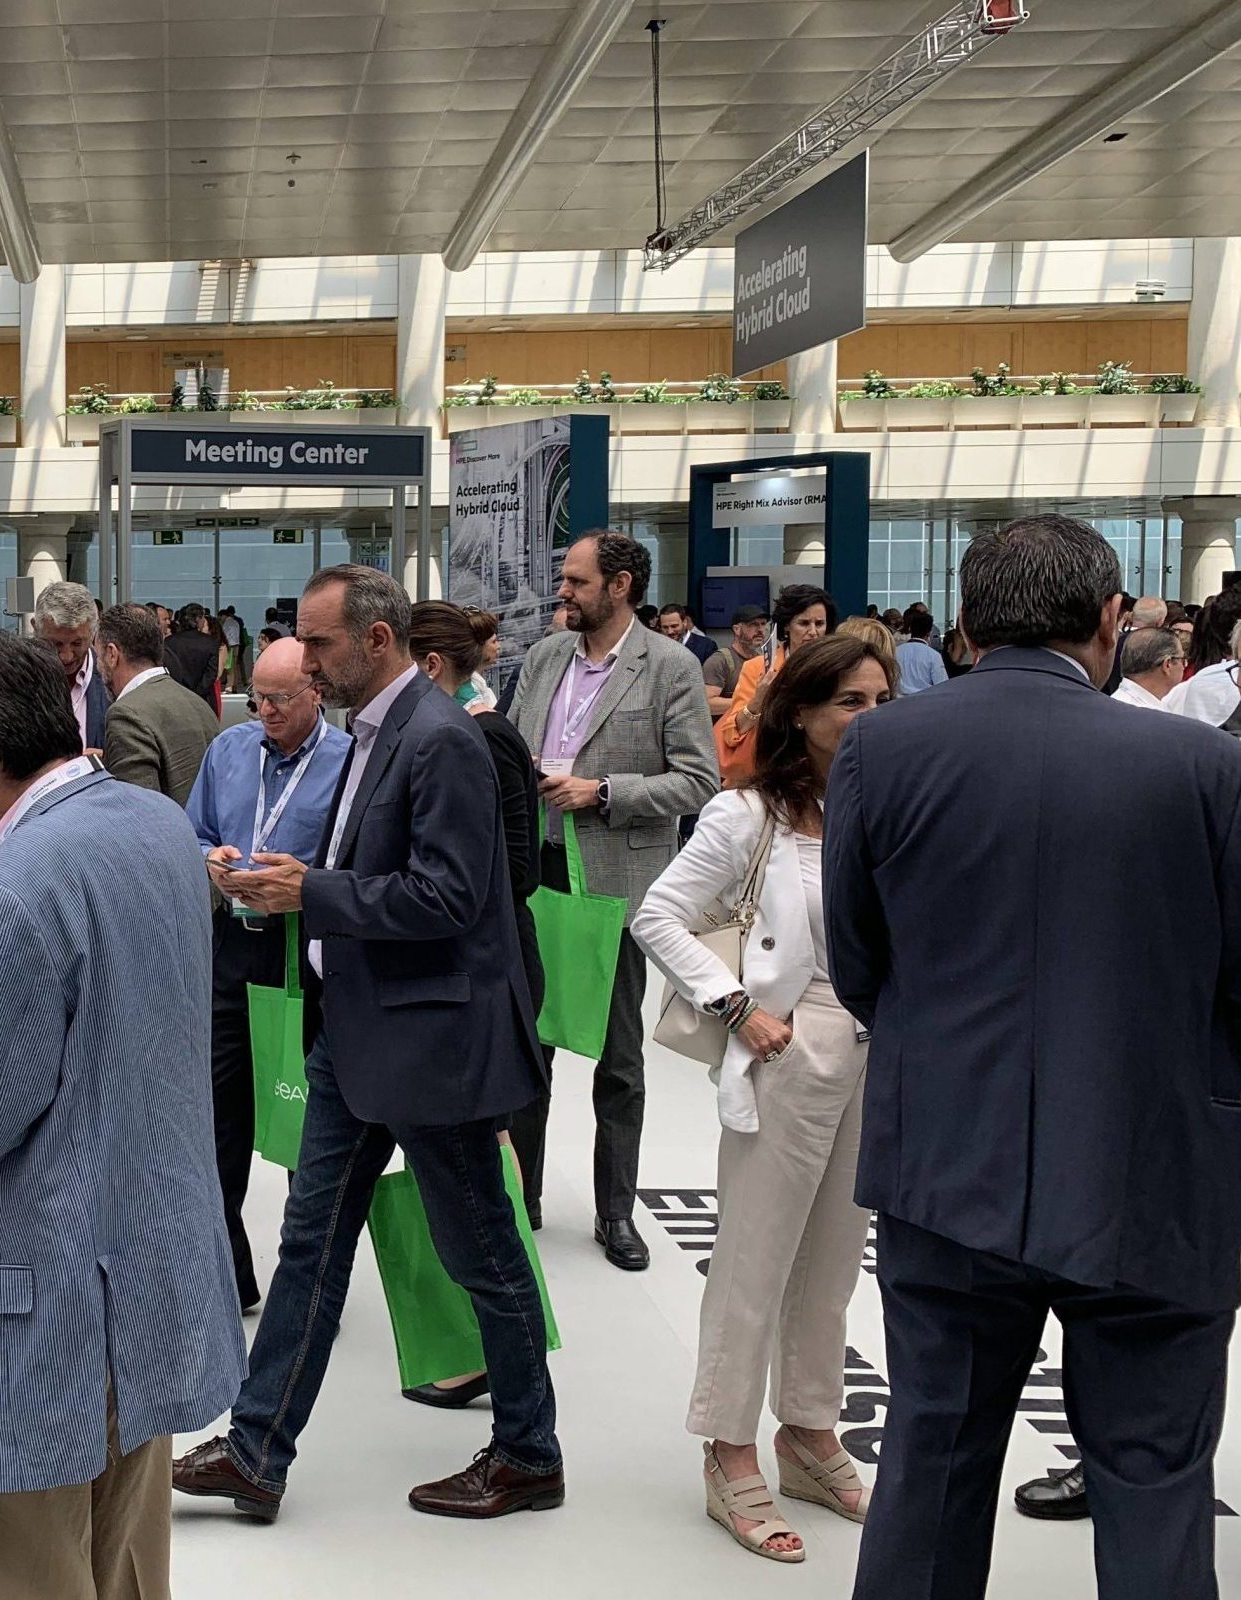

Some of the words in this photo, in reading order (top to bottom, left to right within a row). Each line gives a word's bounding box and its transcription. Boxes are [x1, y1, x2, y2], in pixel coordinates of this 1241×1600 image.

[737, 245, 807, 303] Accelerating
[737, 296, 774, 344] Hybrid
[776, 277, 810, 323] Cloud
[185, 439, 284, 468] Meeting
[290, 441, 369, 464] Center
[466, 455, 487, 463] Discover
[456, 480, 518, 498] Accelerating
[456, 500, 489, 518] Hybrid
[491, 498, 520, 513] Cloud
[717, 501, 732, 510] HPE
[734, 499, 754, 511] Right
[756, 499, 770, 507] Mix
[771, 497, 802, 507] Advisor
